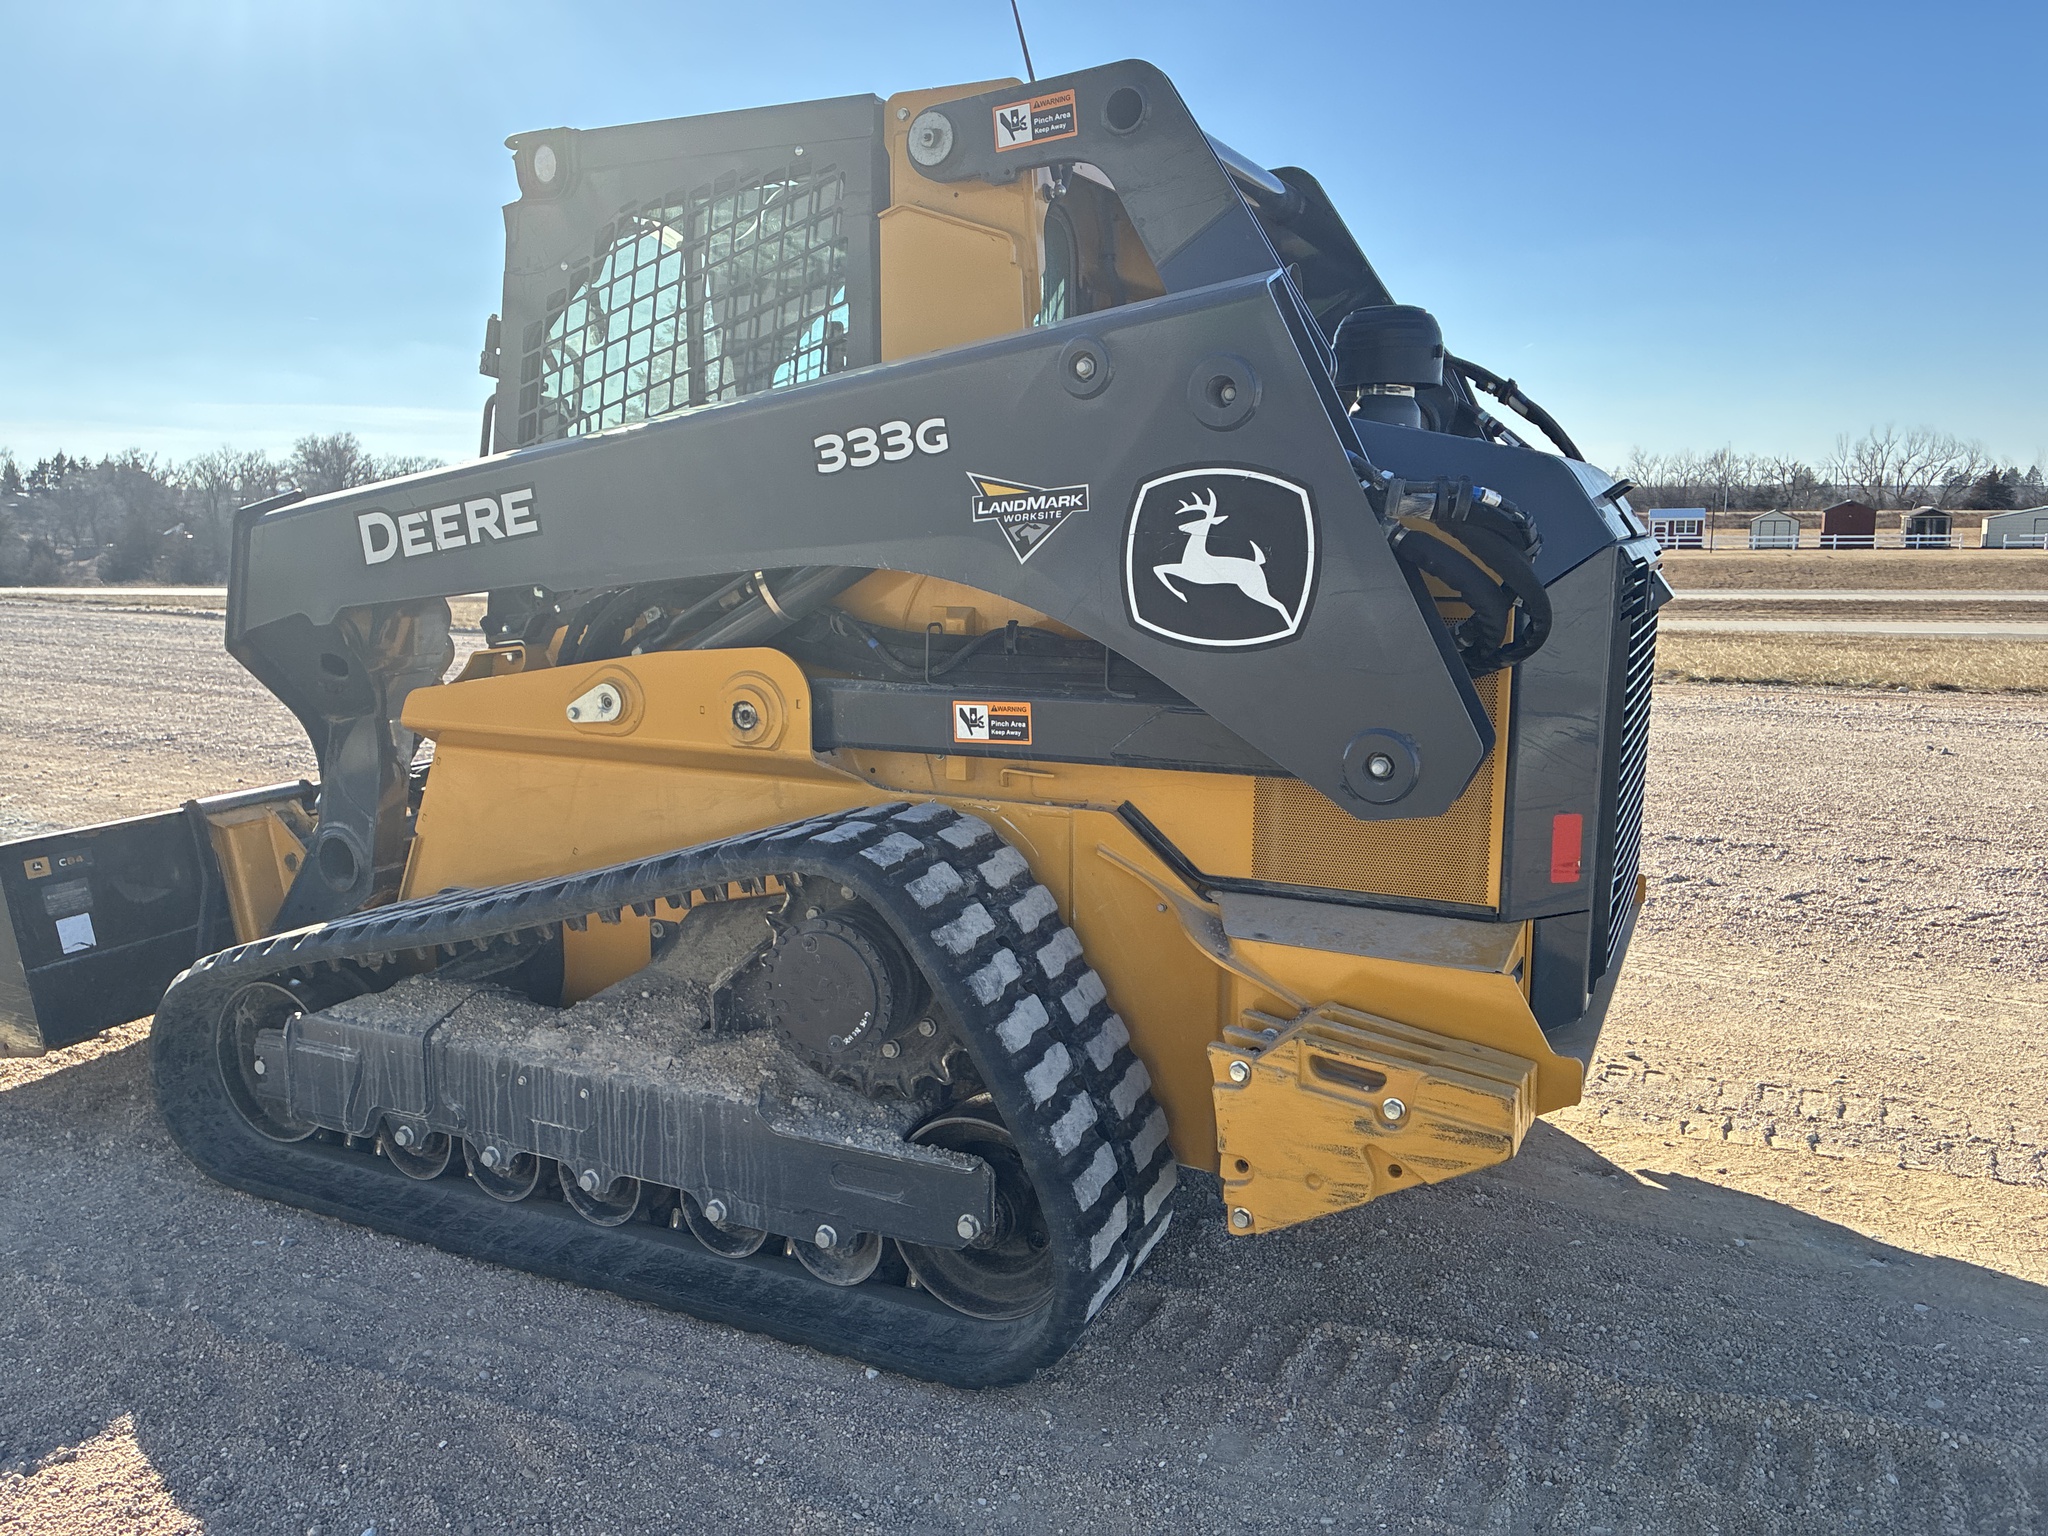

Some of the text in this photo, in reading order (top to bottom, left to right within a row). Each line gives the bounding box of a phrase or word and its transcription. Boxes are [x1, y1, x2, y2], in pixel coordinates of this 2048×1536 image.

[1039, 94, 1071, 107] WARNING
[1033, 111, 1071, 125] Pinch Area
[1034, 126, 1050, 134] Keep
[1050, 122, 1067, 131] Away
[813, 417, 949, 474] 333G
[977, 493, 1084, 516] LANDMARK
[1003, 509, 1063, 523] WORKSITE
[357, 487, 539, 566] DEERE
[997, 705, 1027, 713] WARNING
[990, 719, 1027, 728] Pinch Area
[1006, 729, 1022, 738] Away
